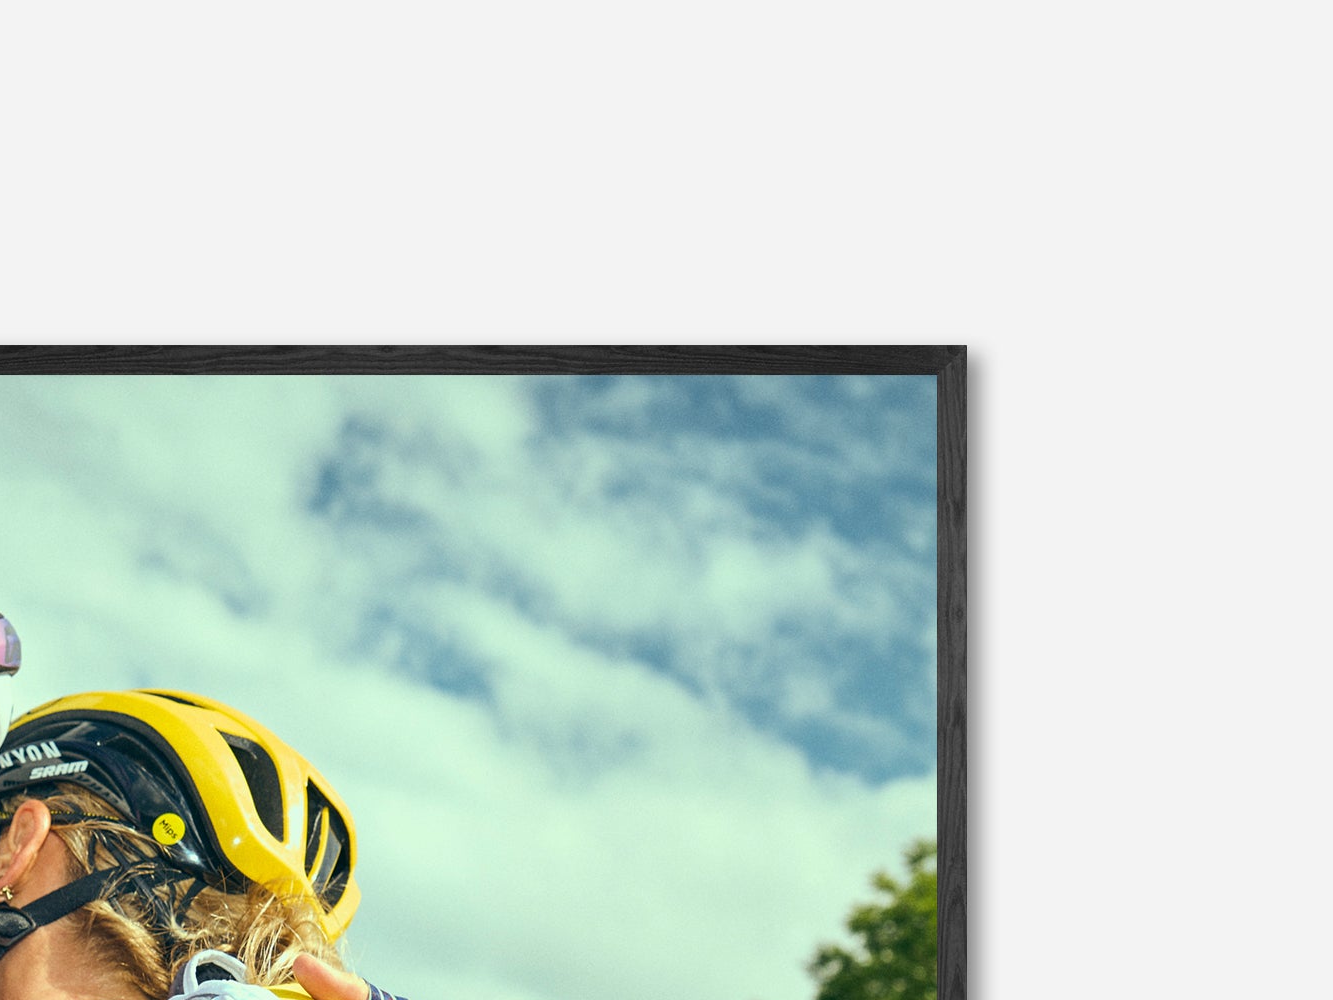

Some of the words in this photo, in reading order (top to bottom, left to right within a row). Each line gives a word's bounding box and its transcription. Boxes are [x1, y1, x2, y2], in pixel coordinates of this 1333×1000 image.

[0, 741, 61, 769] NYON
[29, 760, 88, 780] SRAM
[159, 819, 178, 840] Mips
